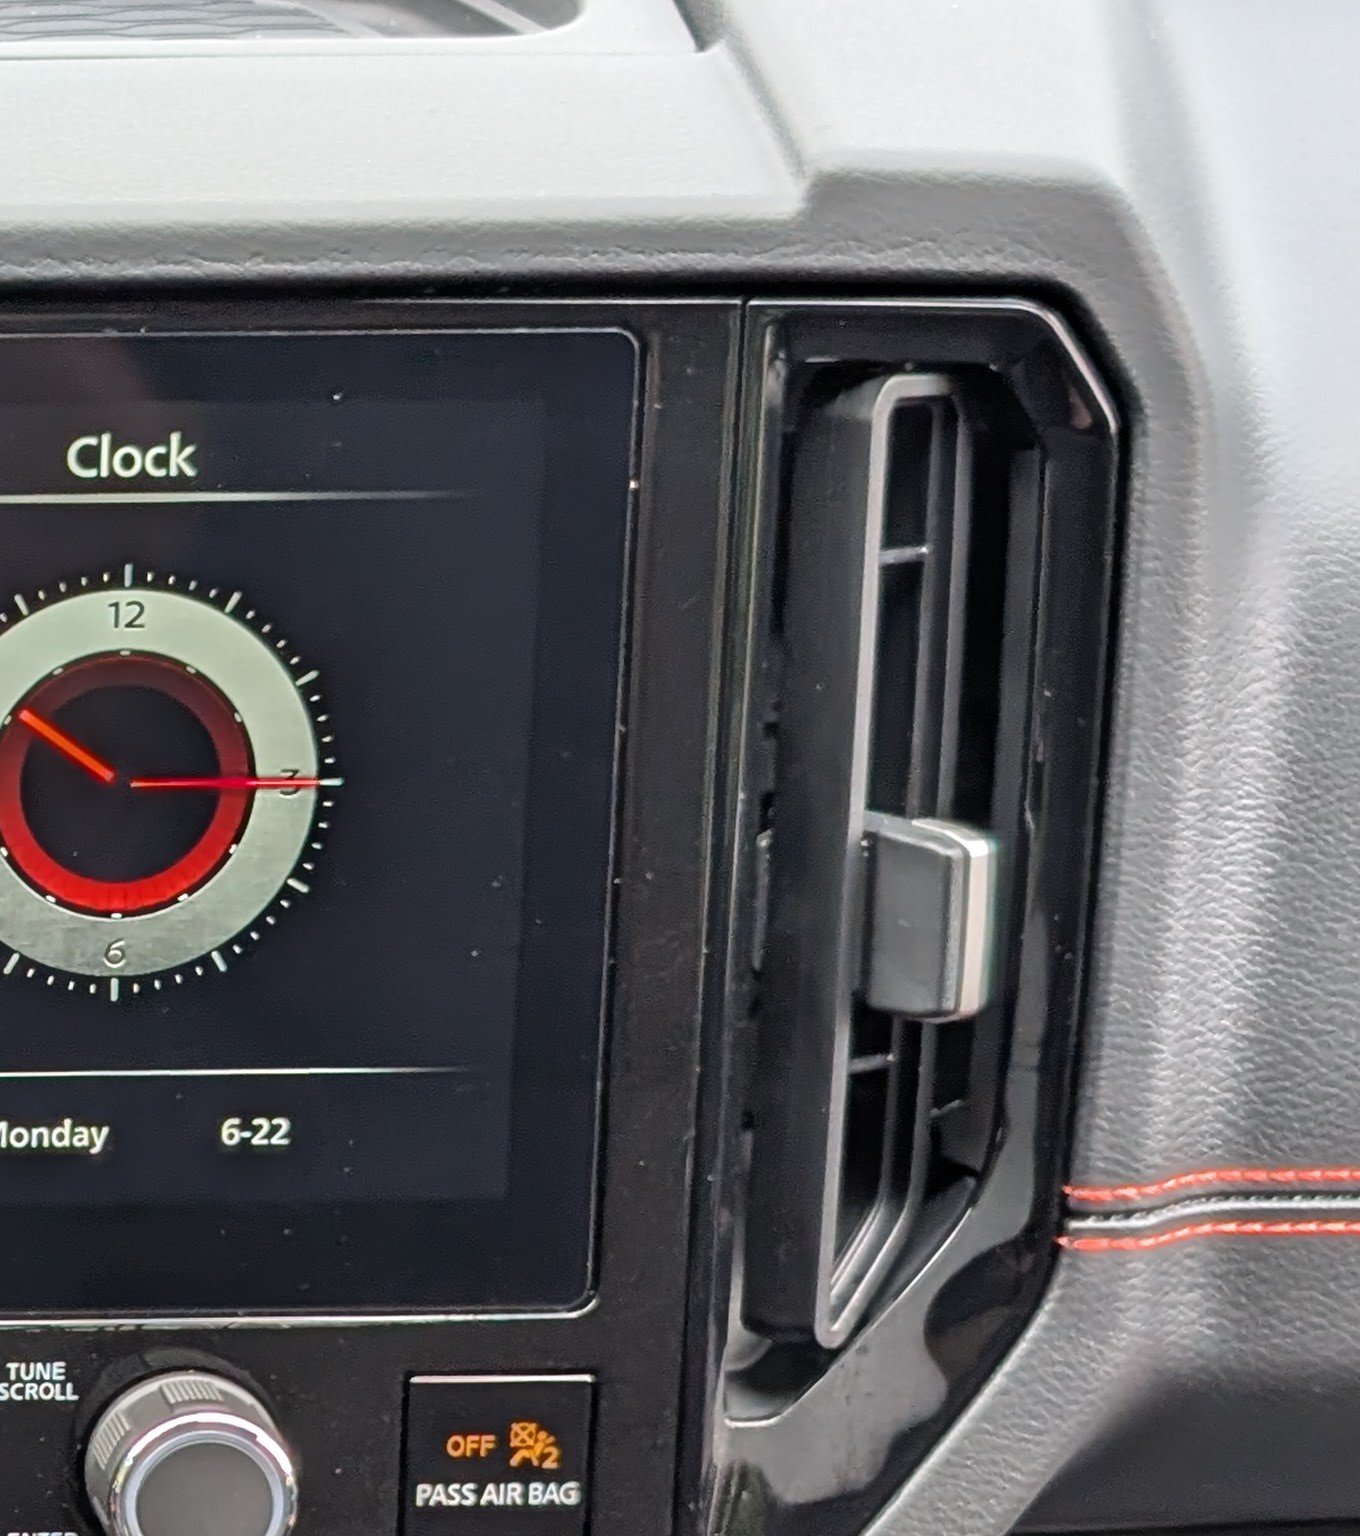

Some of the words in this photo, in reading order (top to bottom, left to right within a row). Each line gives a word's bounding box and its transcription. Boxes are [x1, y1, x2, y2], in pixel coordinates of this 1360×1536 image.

[66, 433, 199, 480] Clock
[106, 600, 147, 631] 12
[103, 940, 127, 969] 6
[220, 1118, 293, 1146] 6-22
[6, 1362, 66, 1381] TUNE
[446, 1433, 497, 1458] OFF
[415, 1482, 479, 1507] PASS
[480, 1482, 525, 1507] AIR
[528, 1480, 580, 1507] BAG
